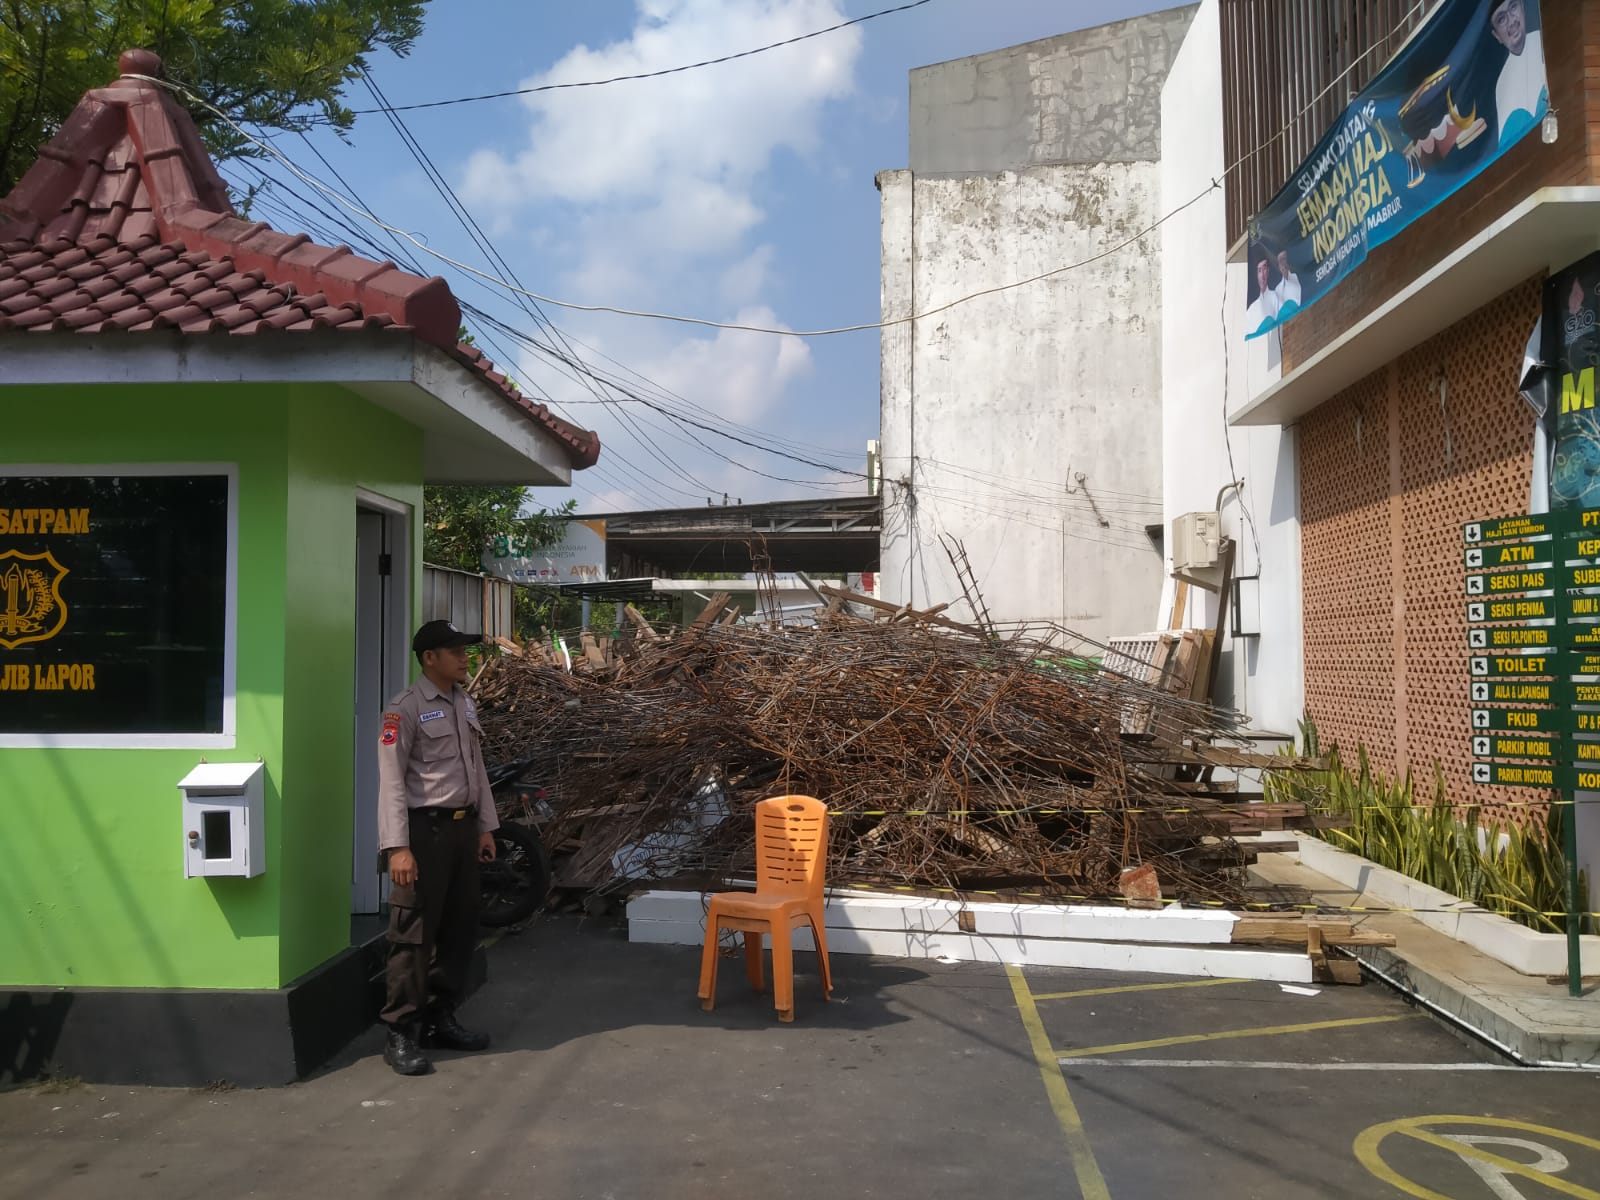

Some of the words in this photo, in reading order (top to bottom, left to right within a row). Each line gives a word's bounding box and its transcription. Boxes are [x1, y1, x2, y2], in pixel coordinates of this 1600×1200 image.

[1296, 158, 1353, 239] JEMAAH
[1352, 118, 1393, 179] HAJI
[1311, 165, 1393, 264] INDONESIA
[1367, 196, 1402, 231] MABRUR
[1565, 309, 1595, 333] G20
[1561, 367, 1595, 414] M
[0, 508, 89, 534] SATPAM
[1498, 518, 1531, 530] LAYANAN
[1486, 529, 1502, 538] HAJI
[1503, 527, 1518, 536] DAN
[1500, 546, 1535, 562] ATM
[570, 565, 598, 576] ATM
[1490, 575, 1519, 590] SEKSI
[1522, 572, 1545, 588] PAIS
[1491, 603, 1514, 618] SEKSI
[1516, 601, 1545, 616] PENMA
[1572, 599, 1592, 614] UMUM
[1593, 598, 1599, 613] &
[1493, 630, 1510, 645] SEKSI
[1495, 657, 1546, 672] TOILET
[34, 663, 95, 690] LAPOR
[1495, 685, 1510, 699] AULA
[1517, 685, 1550, 700] LAPANGAN
[1507, 712, 1538, 727] FKUB
[1578, 715, 1588, 729] UP
[1589, 715, 1596, 730] &
[1497, 740, 1525, 755] PARKIR
[1526, 741, 1552, 756] MOBIL
[1498, 767, 1522, 782] PARKIR
[1523, 769, 1553, 785] MOTOOR
